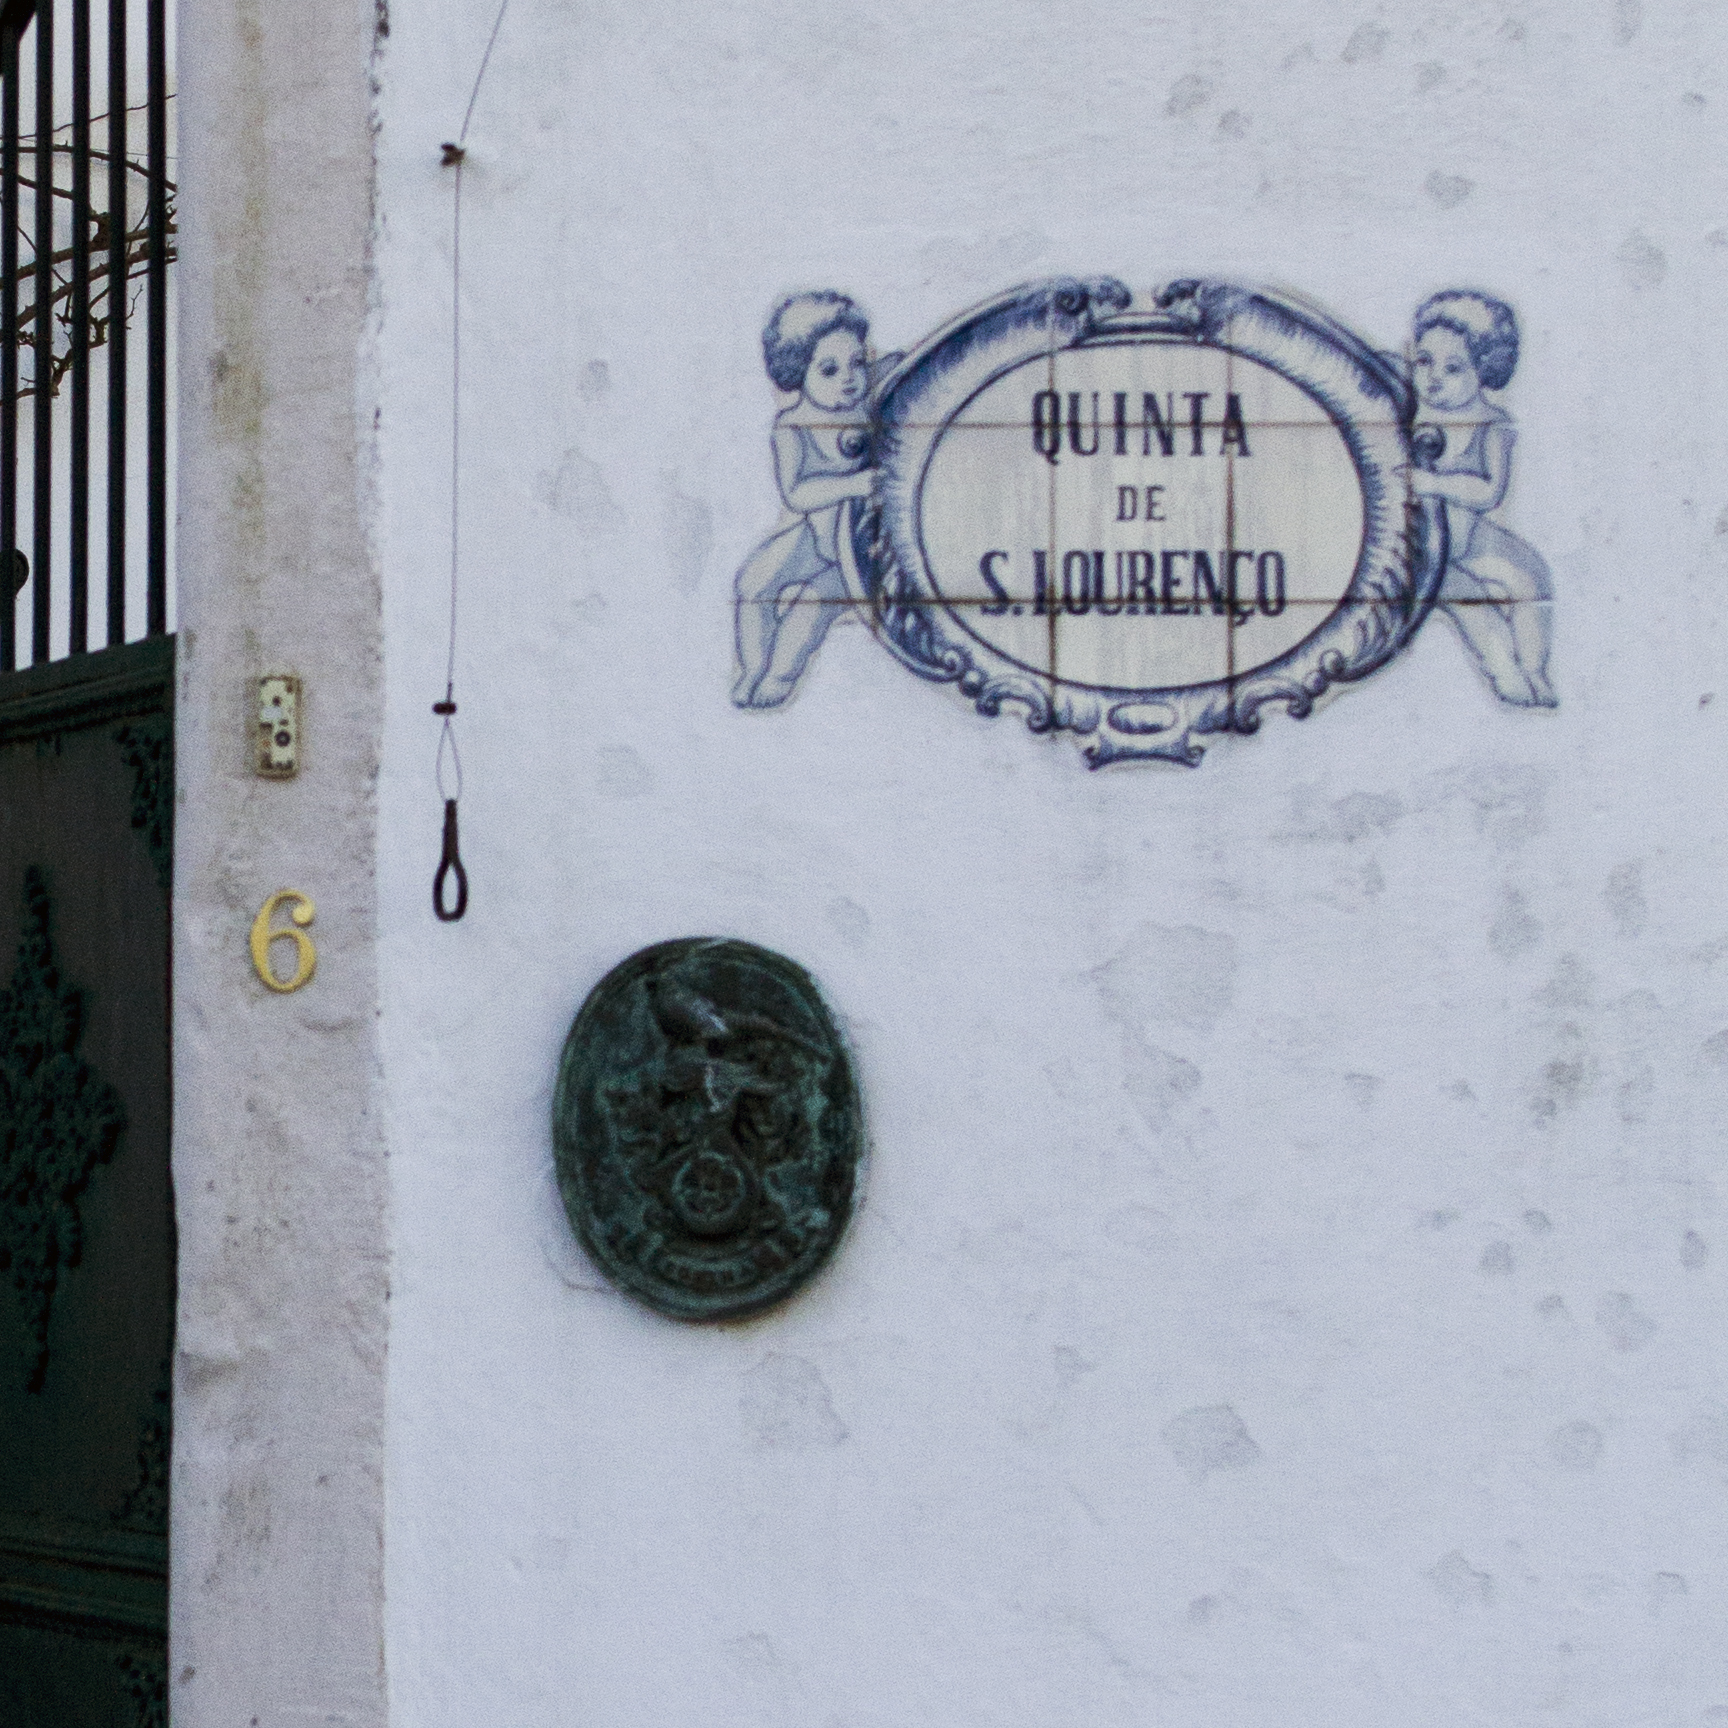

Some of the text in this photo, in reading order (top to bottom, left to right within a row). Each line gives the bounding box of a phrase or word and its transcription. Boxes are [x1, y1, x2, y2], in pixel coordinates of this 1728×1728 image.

[1032, 390, 1252, 465] QUINTA
[1116, 485, 1167, 522] DE
[249, 889, 317, 994] 6
